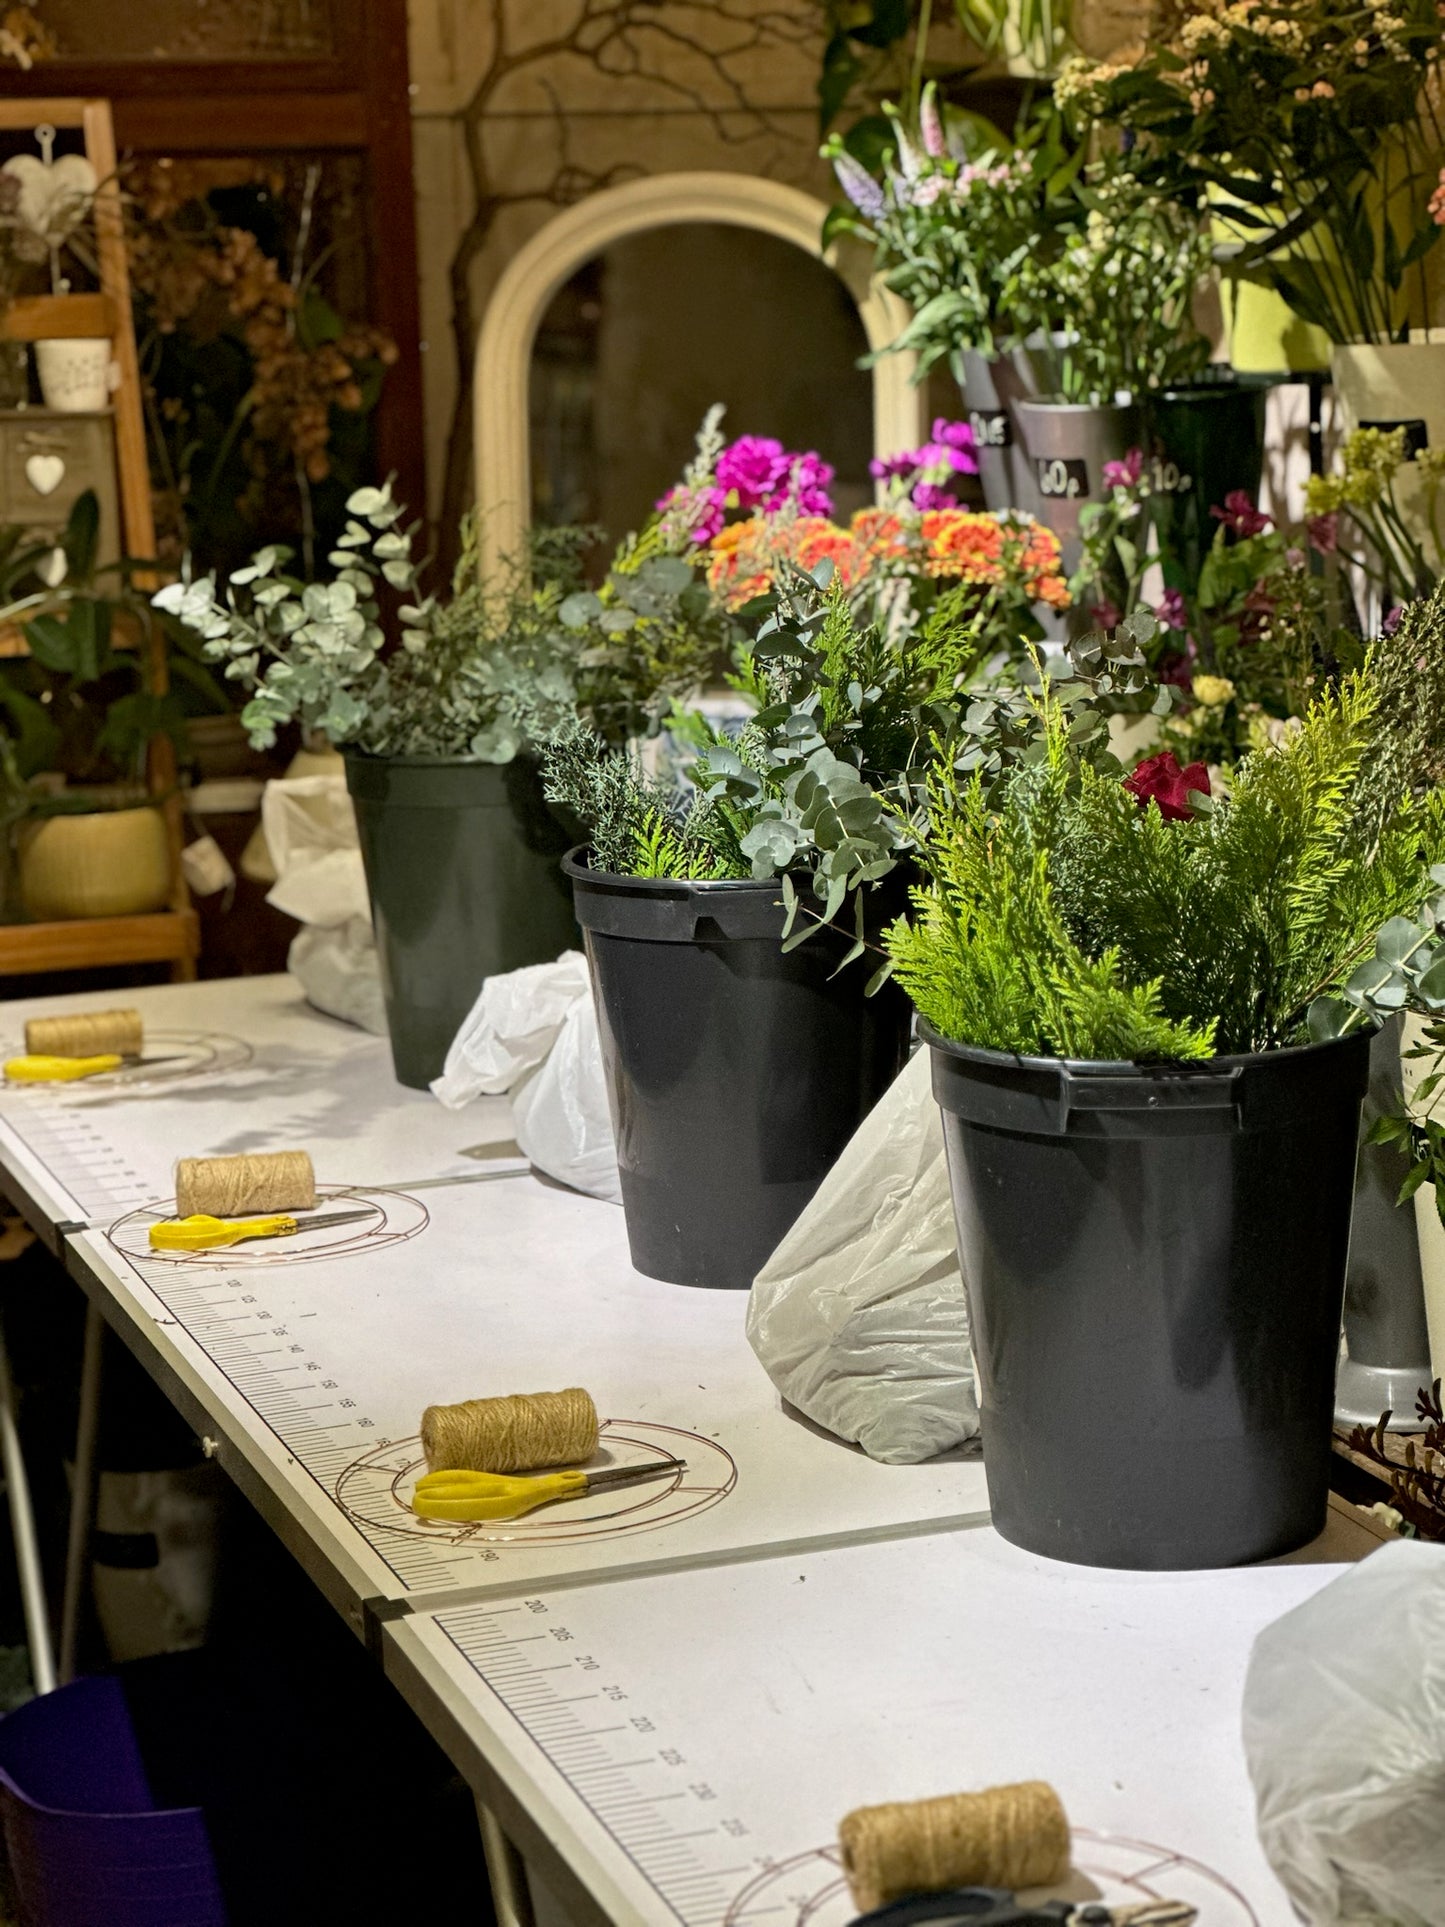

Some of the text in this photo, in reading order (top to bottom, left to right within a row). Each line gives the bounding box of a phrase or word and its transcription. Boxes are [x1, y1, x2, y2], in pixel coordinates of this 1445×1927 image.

[304, 1361, 322, 1371] 145
[320, 1379, 338, 1389] 150
[338, 1398, 356, 1408] 155
[355, 1417, 375, 1427] 160
[478, 1549, 499, 1561] 190
[524, 1599, 548, 1613] 200
[549, 1627, 574, 1641] 205
[574, 1655, 600, 1670] 210
[602, 1685, 628, 1701] 215
[629, 1716, 657, 1733] 220
[657, 1747, 687, 1766] 225
[688, 1782, 718, 1801] 230
